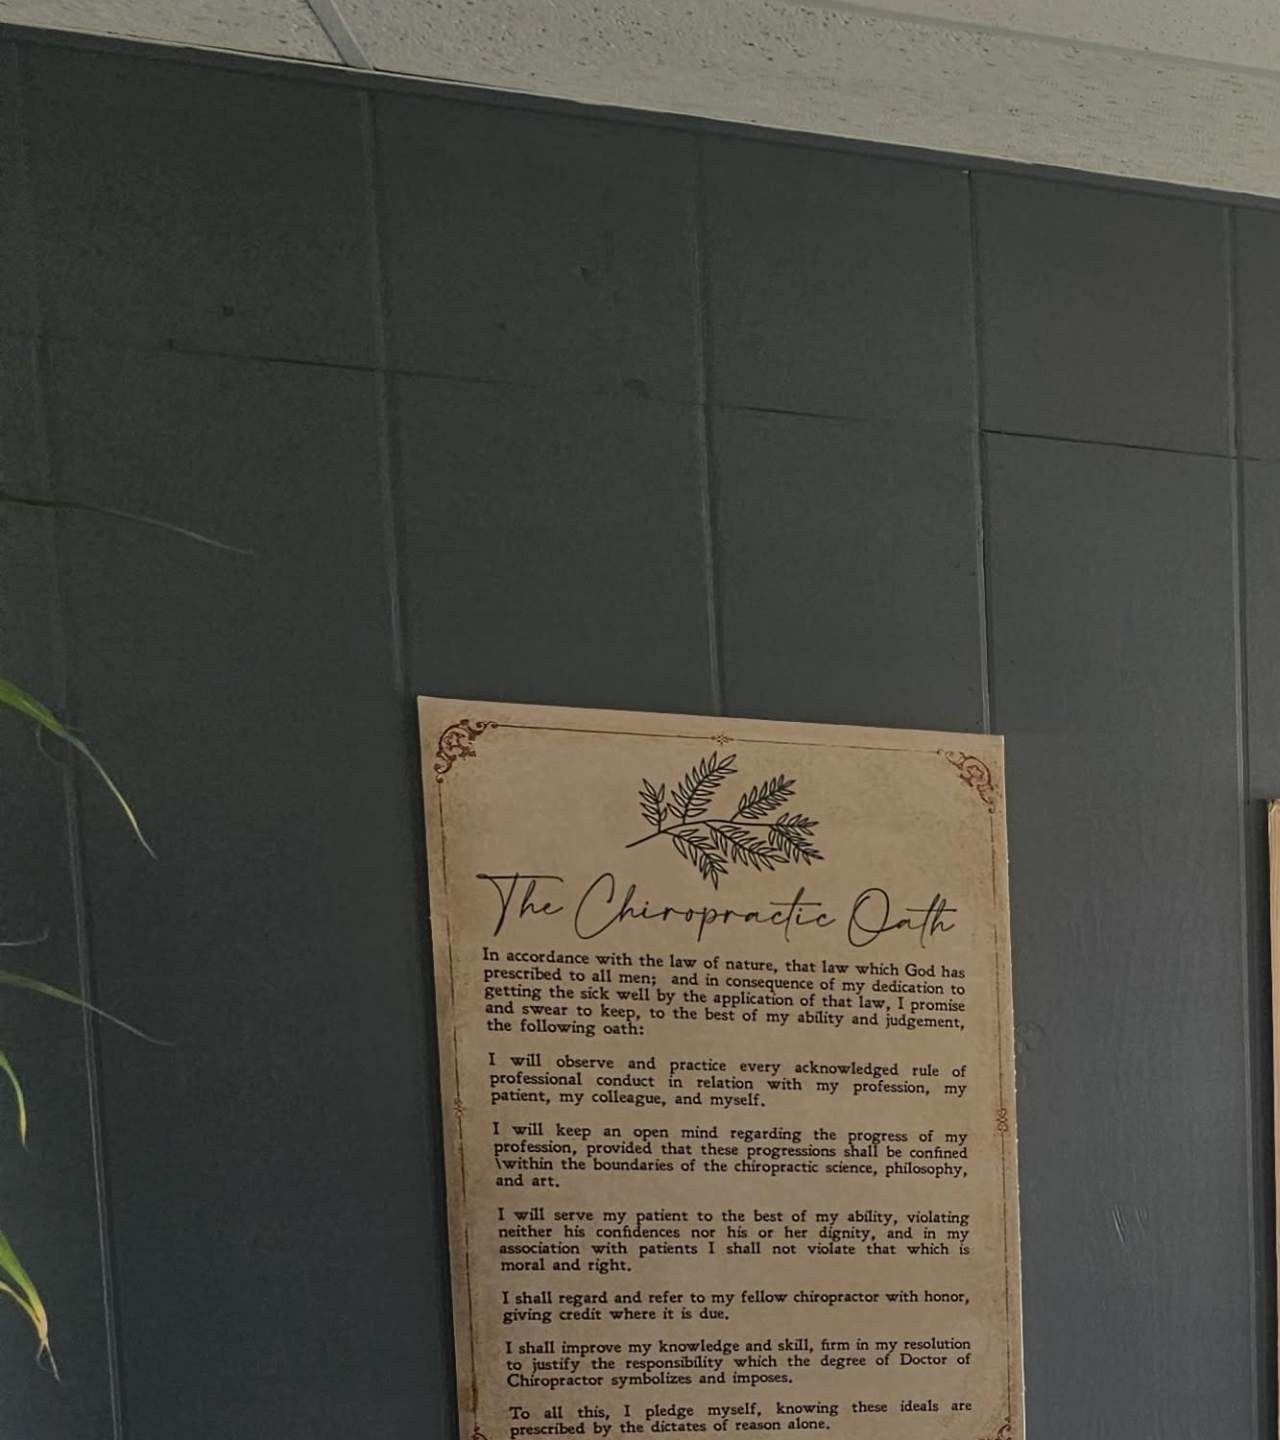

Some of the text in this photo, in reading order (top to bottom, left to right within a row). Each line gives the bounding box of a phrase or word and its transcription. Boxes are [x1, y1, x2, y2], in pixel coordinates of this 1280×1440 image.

[476, 872, 958, 949] The Chiropractic Oath
[482, 947, 965, 978] In accordance with the law of nature, that law which God has
[484, 964, 965, 995] prescribed to all men; and in consequence of my dedication to
[484, 982, 965, 1014] getting the sick well by the application of that law, I promise
[485, 999, 965, 1030] and swear to keep, to the best of my ability and judgement,
[486, 1016, 644, 1036] the following oath:
